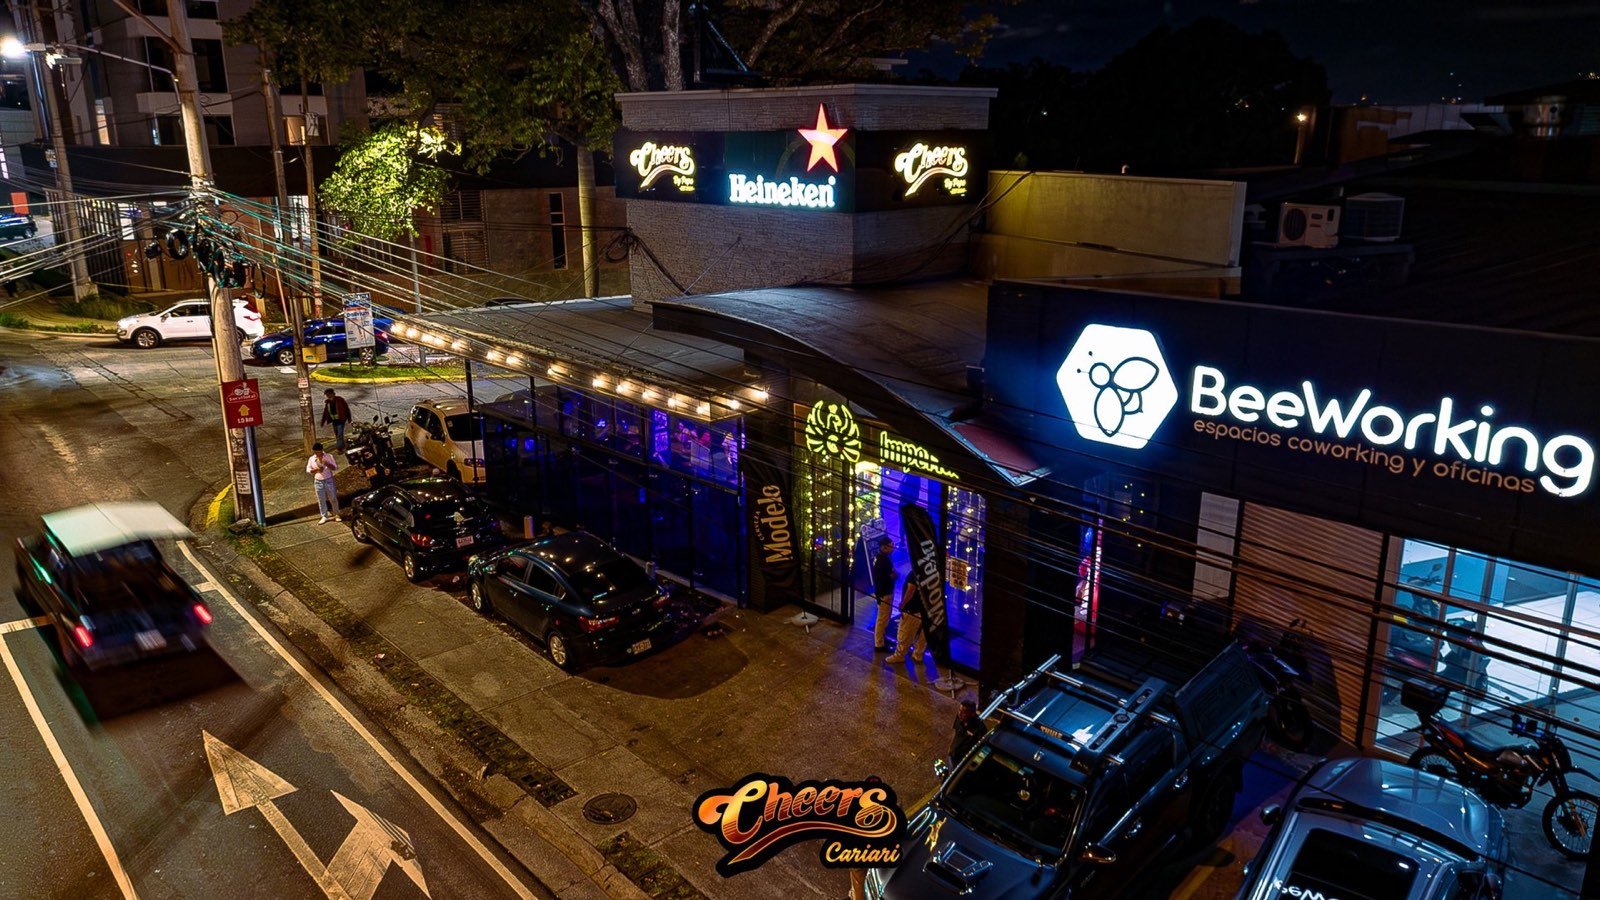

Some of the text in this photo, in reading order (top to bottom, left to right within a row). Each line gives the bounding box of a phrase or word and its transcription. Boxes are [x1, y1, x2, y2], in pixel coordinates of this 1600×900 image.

[630, 141, 695, 178] Cheers
[894, 142, 968, 184] Cheers
[728, 173, 836, 208] Heineken
[1191, 365, 1595, 498] BeeWorking
[1193, 418, 1536, 494] espacios coworking y oficinas
[757, 485, 792, 563] Modelo
